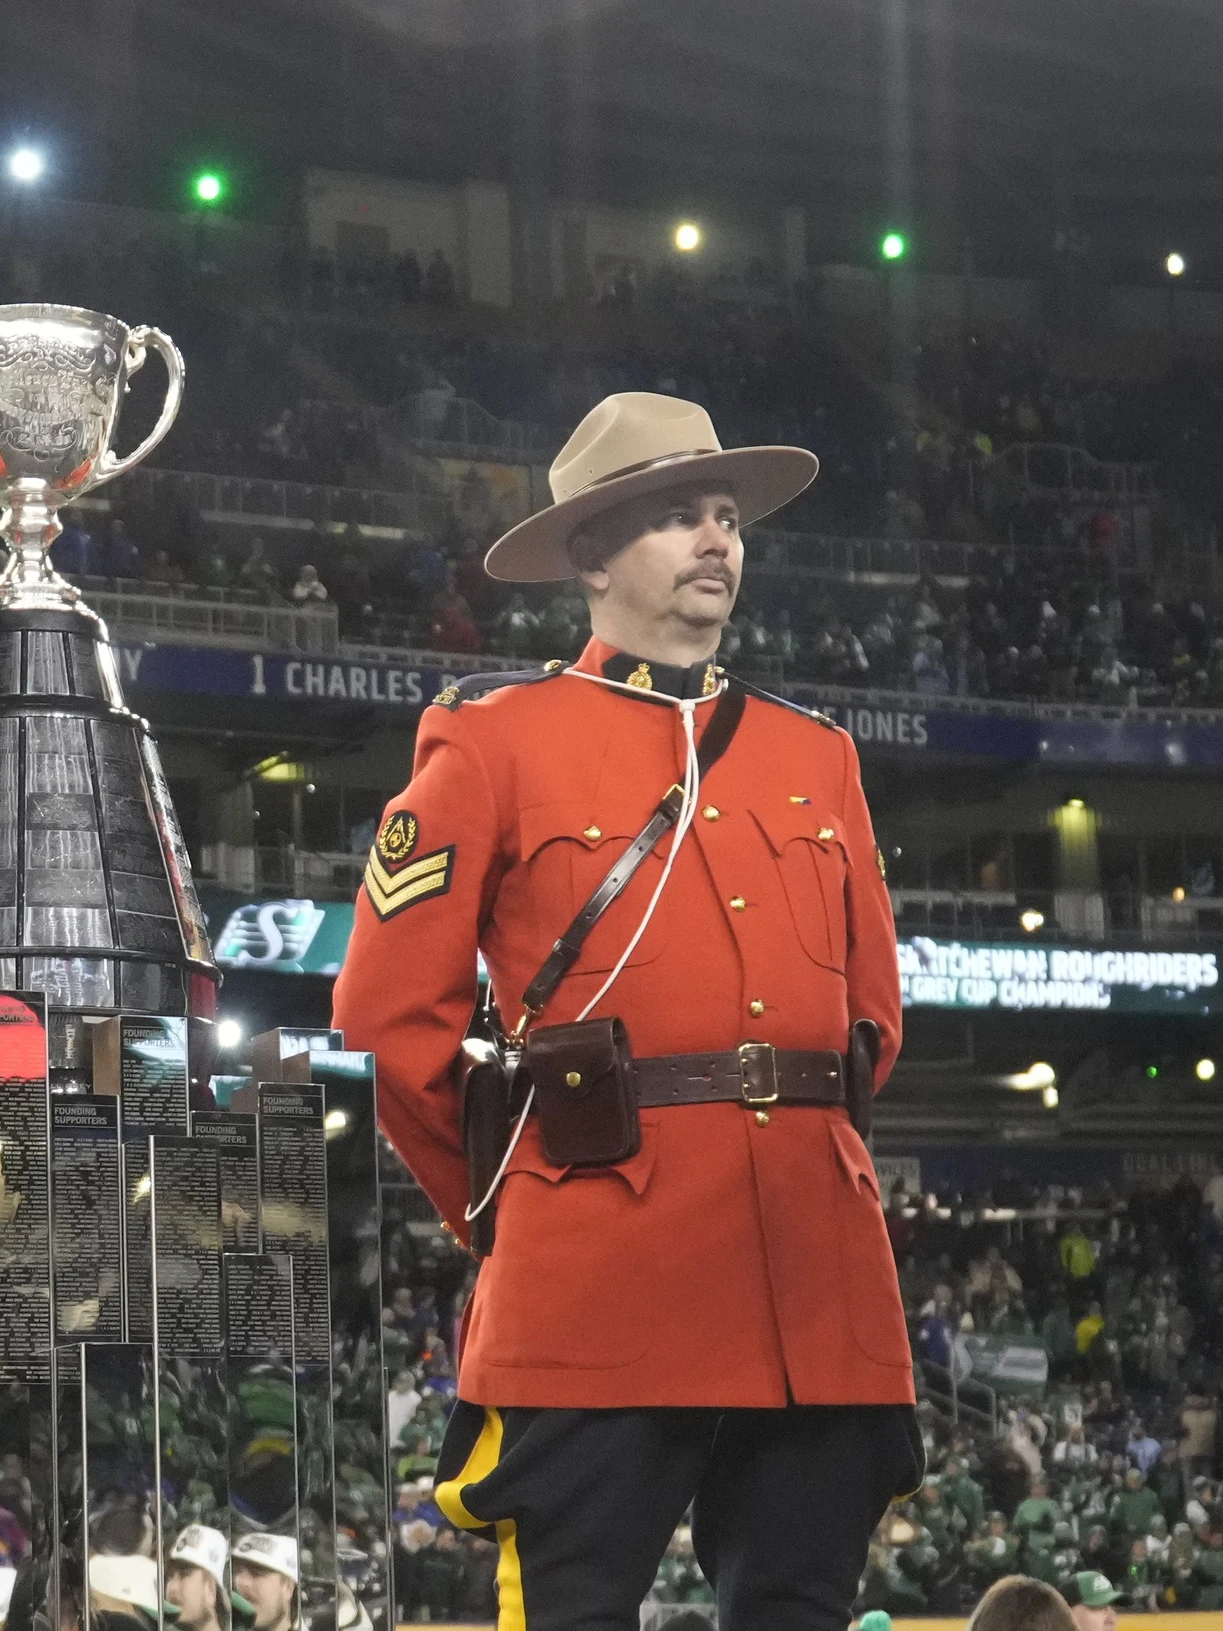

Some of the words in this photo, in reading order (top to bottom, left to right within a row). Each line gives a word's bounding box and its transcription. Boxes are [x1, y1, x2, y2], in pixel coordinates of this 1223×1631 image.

[252, 654, 266, 694] 1
[285, 661, 423, 704] CHARLES
[846, 708, 928, 744] JONES
[1050, 951, 1218, 987] ROUGHRIDERS
[911, 976, 958, 1001] GREY
[960, 979, 997, 1004] CUP
[123, 1028, 165, 1038] FOUNDING
[123, 1037, 175, 1048] SUPPORTERS
[263, 1096, 304, 1106] FOUNDING
[54, 1107, 97, 1116] FOUNDING
[263, 1106, 314, 1115] SUPPORTERS
[54, 1115, 108, 1126] SUPPORTERS
[195, 1125, 237, 1135] FOUNDING
[195, 1134, 247, 1144] RTERS
